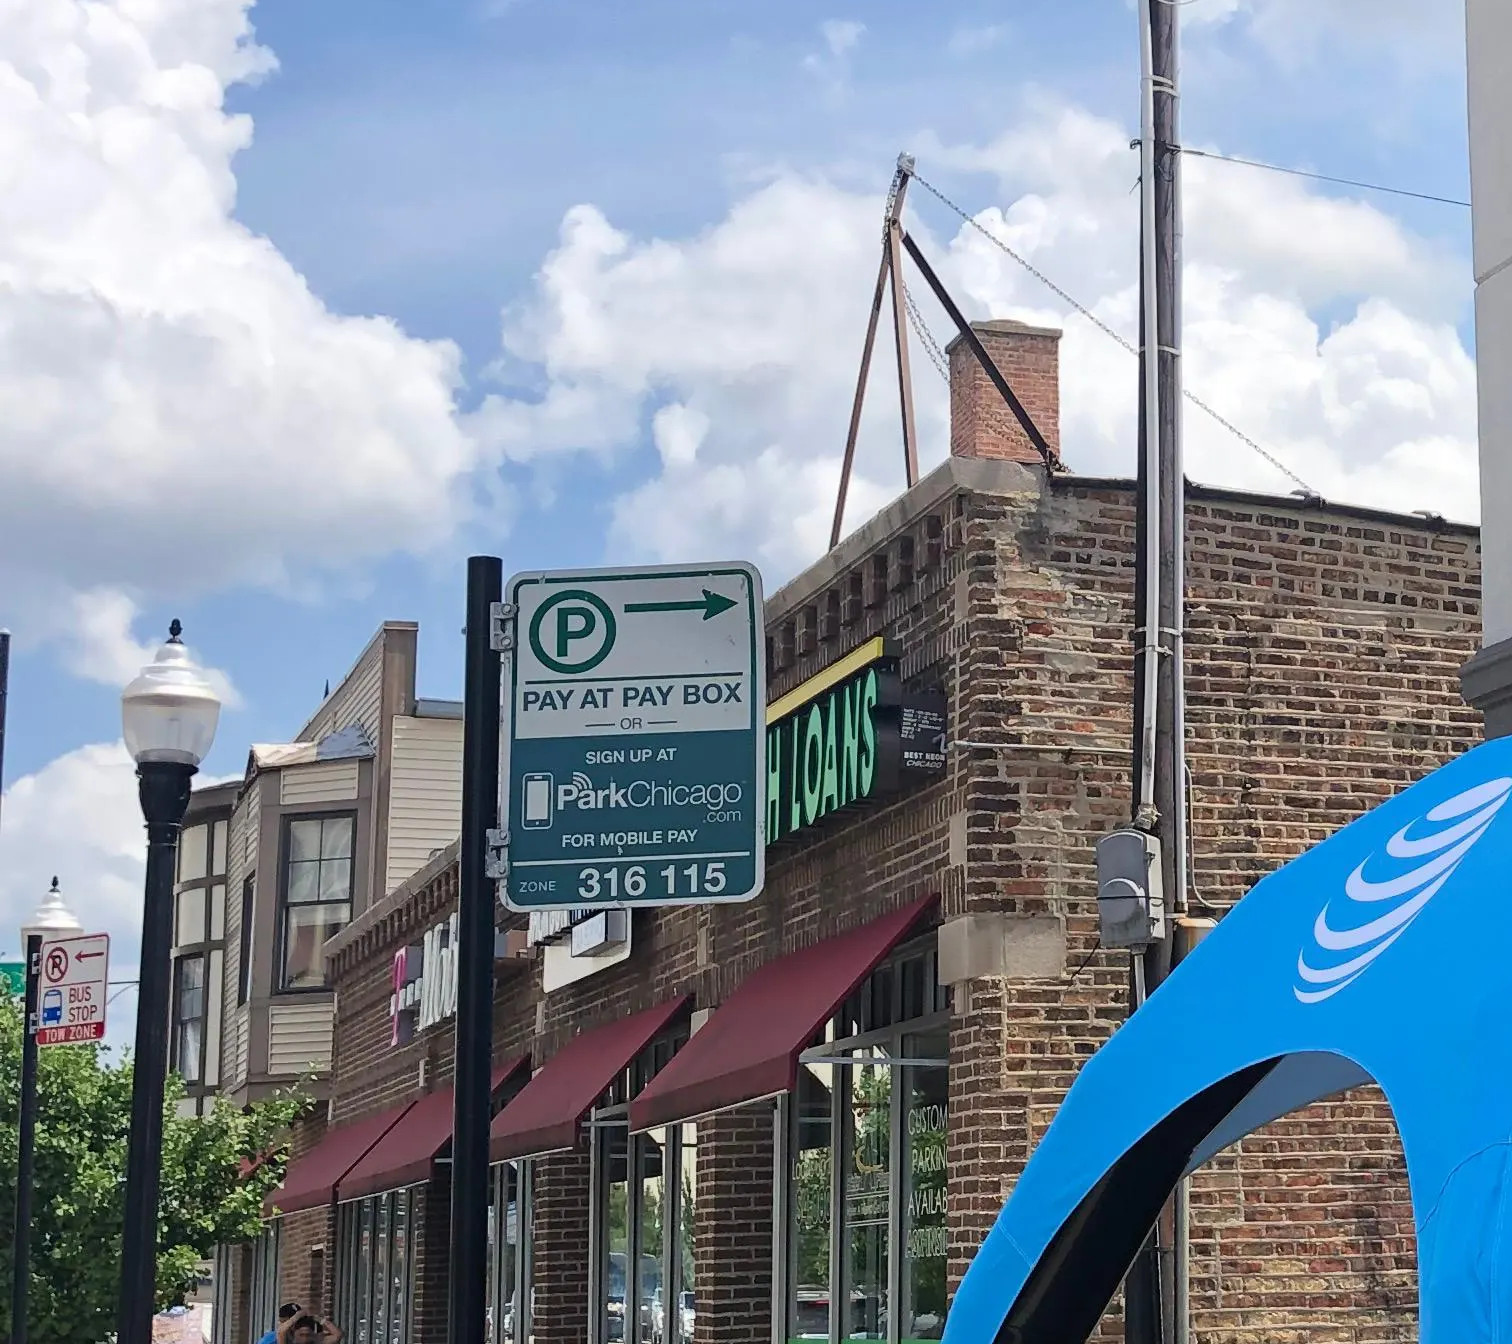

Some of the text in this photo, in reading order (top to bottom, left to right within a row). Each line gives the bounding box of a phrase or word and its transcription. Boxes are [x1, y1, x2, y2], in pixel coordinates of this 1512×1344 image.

[522, 682, 743, 712] PAY AT PAY BOX
[620, 717, 643, 730] OR
[585, 747, 677, 765] SIGN UP AT
[790, 668, 877, 833] LOANS
[904, 751, 923, 760] BEST
[906, 760, 942, 768] CHICAGO
[557, 778, 742, 811] ParkChicago
[703, 809, 742, 824] .com
[561, 829, 698, 848] FOR MOBILE PAY
[519, 862, 727, 899] ZONE 316 115
[69, 986, 92, 1004] BUS
[68, 1004, 98, 1023] STOP
[45, 1024, 97, 1042] TOW ZONE
[908, 1104, 948, 1135] CUSTOM
[907, 1187, 948, 1217] AVAILAB
